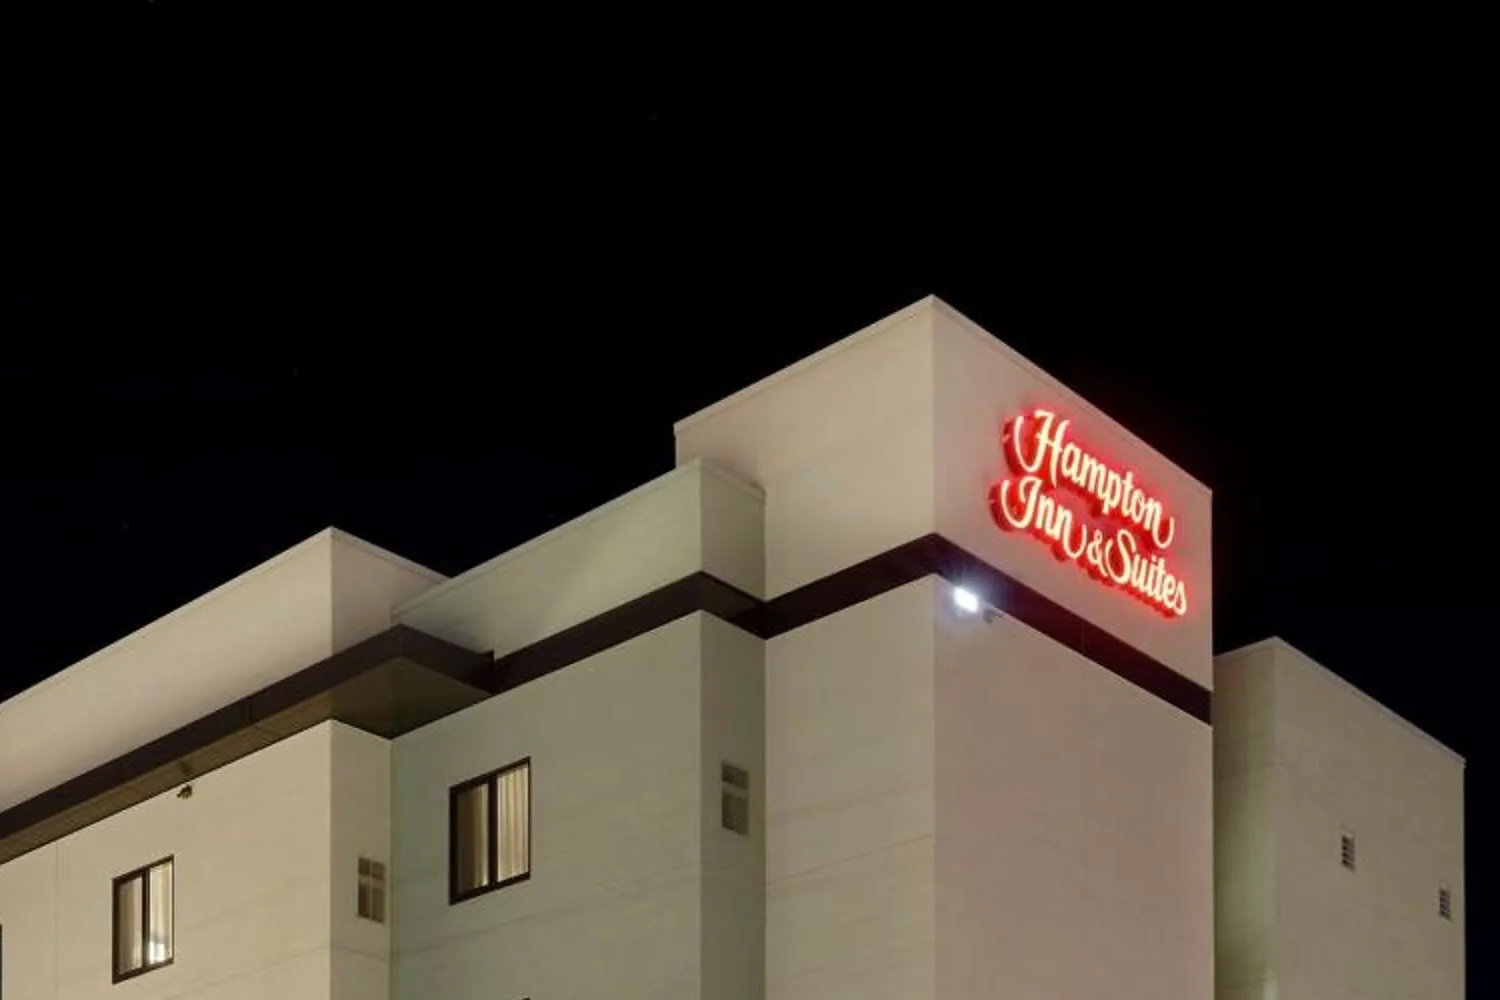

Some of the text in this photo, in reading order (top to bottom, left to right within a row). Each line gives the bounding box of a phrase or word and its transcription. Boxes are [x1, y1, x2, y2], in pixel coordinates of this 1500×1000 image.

[1001, 476, 1188, 615] Inn & Suites
[1013, 409, 1175, 548] Hampton
